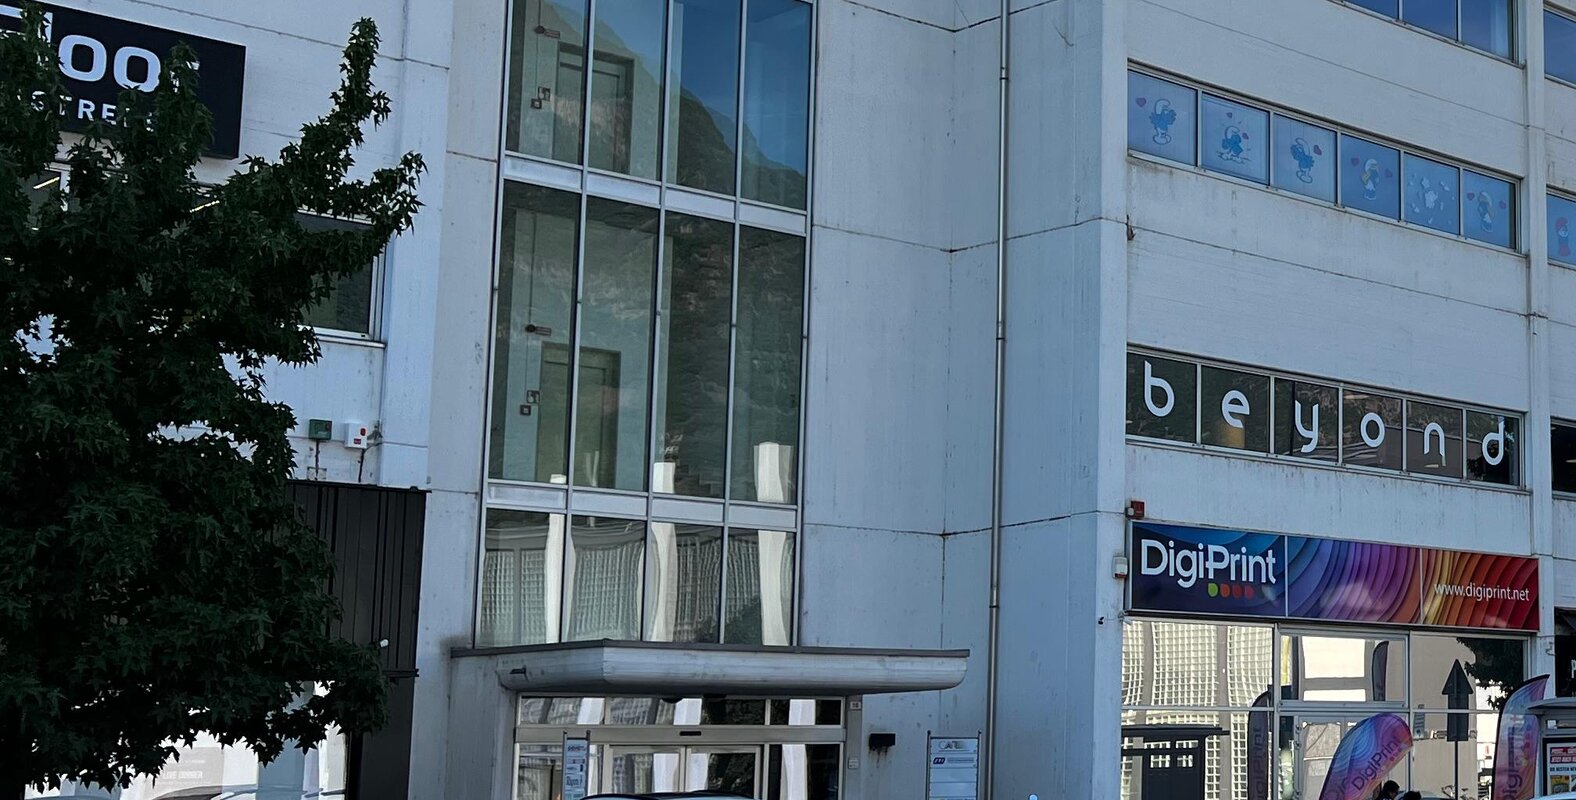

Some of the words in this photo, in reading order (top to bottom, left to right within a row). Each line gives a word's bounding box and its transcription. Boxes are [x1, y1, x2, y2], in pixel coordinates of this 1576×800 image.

[1144, 360, 1505, 466] beyond
[1141, 538, 1277, 588] DigiPrint
[1434, 582, 1530, 602] www.digiprint.net
